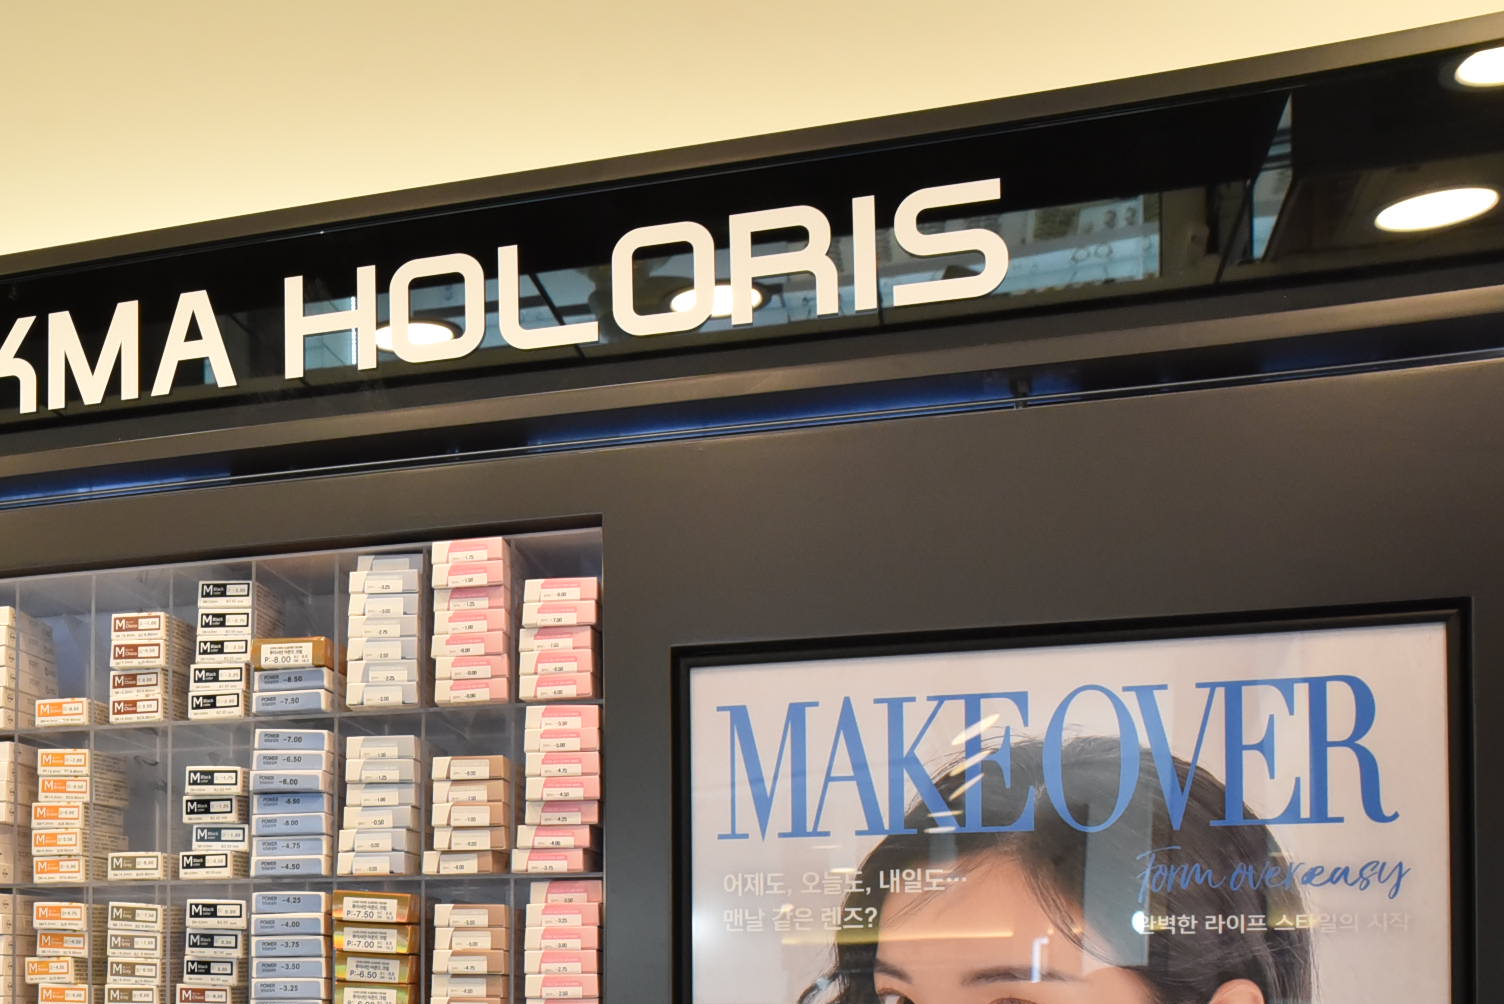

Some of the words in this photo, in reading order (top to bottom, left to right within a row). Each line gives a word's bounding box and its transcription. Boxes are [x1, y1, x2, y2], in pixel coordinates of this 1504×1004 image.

[283, 177, 1010, 379] HOLORIS
[723, 872, 792, 897] 어제도,
[801, 871, 872, 896] 오늘도,
[723, 908, 764, 932] 맨날
[773, 907, 814, 931] 같은
[821, 907, 878, 930] 렌즈?
[1205, 914, 1267, 933] 라이프
[1367, 914, 1410, 931] 시작
